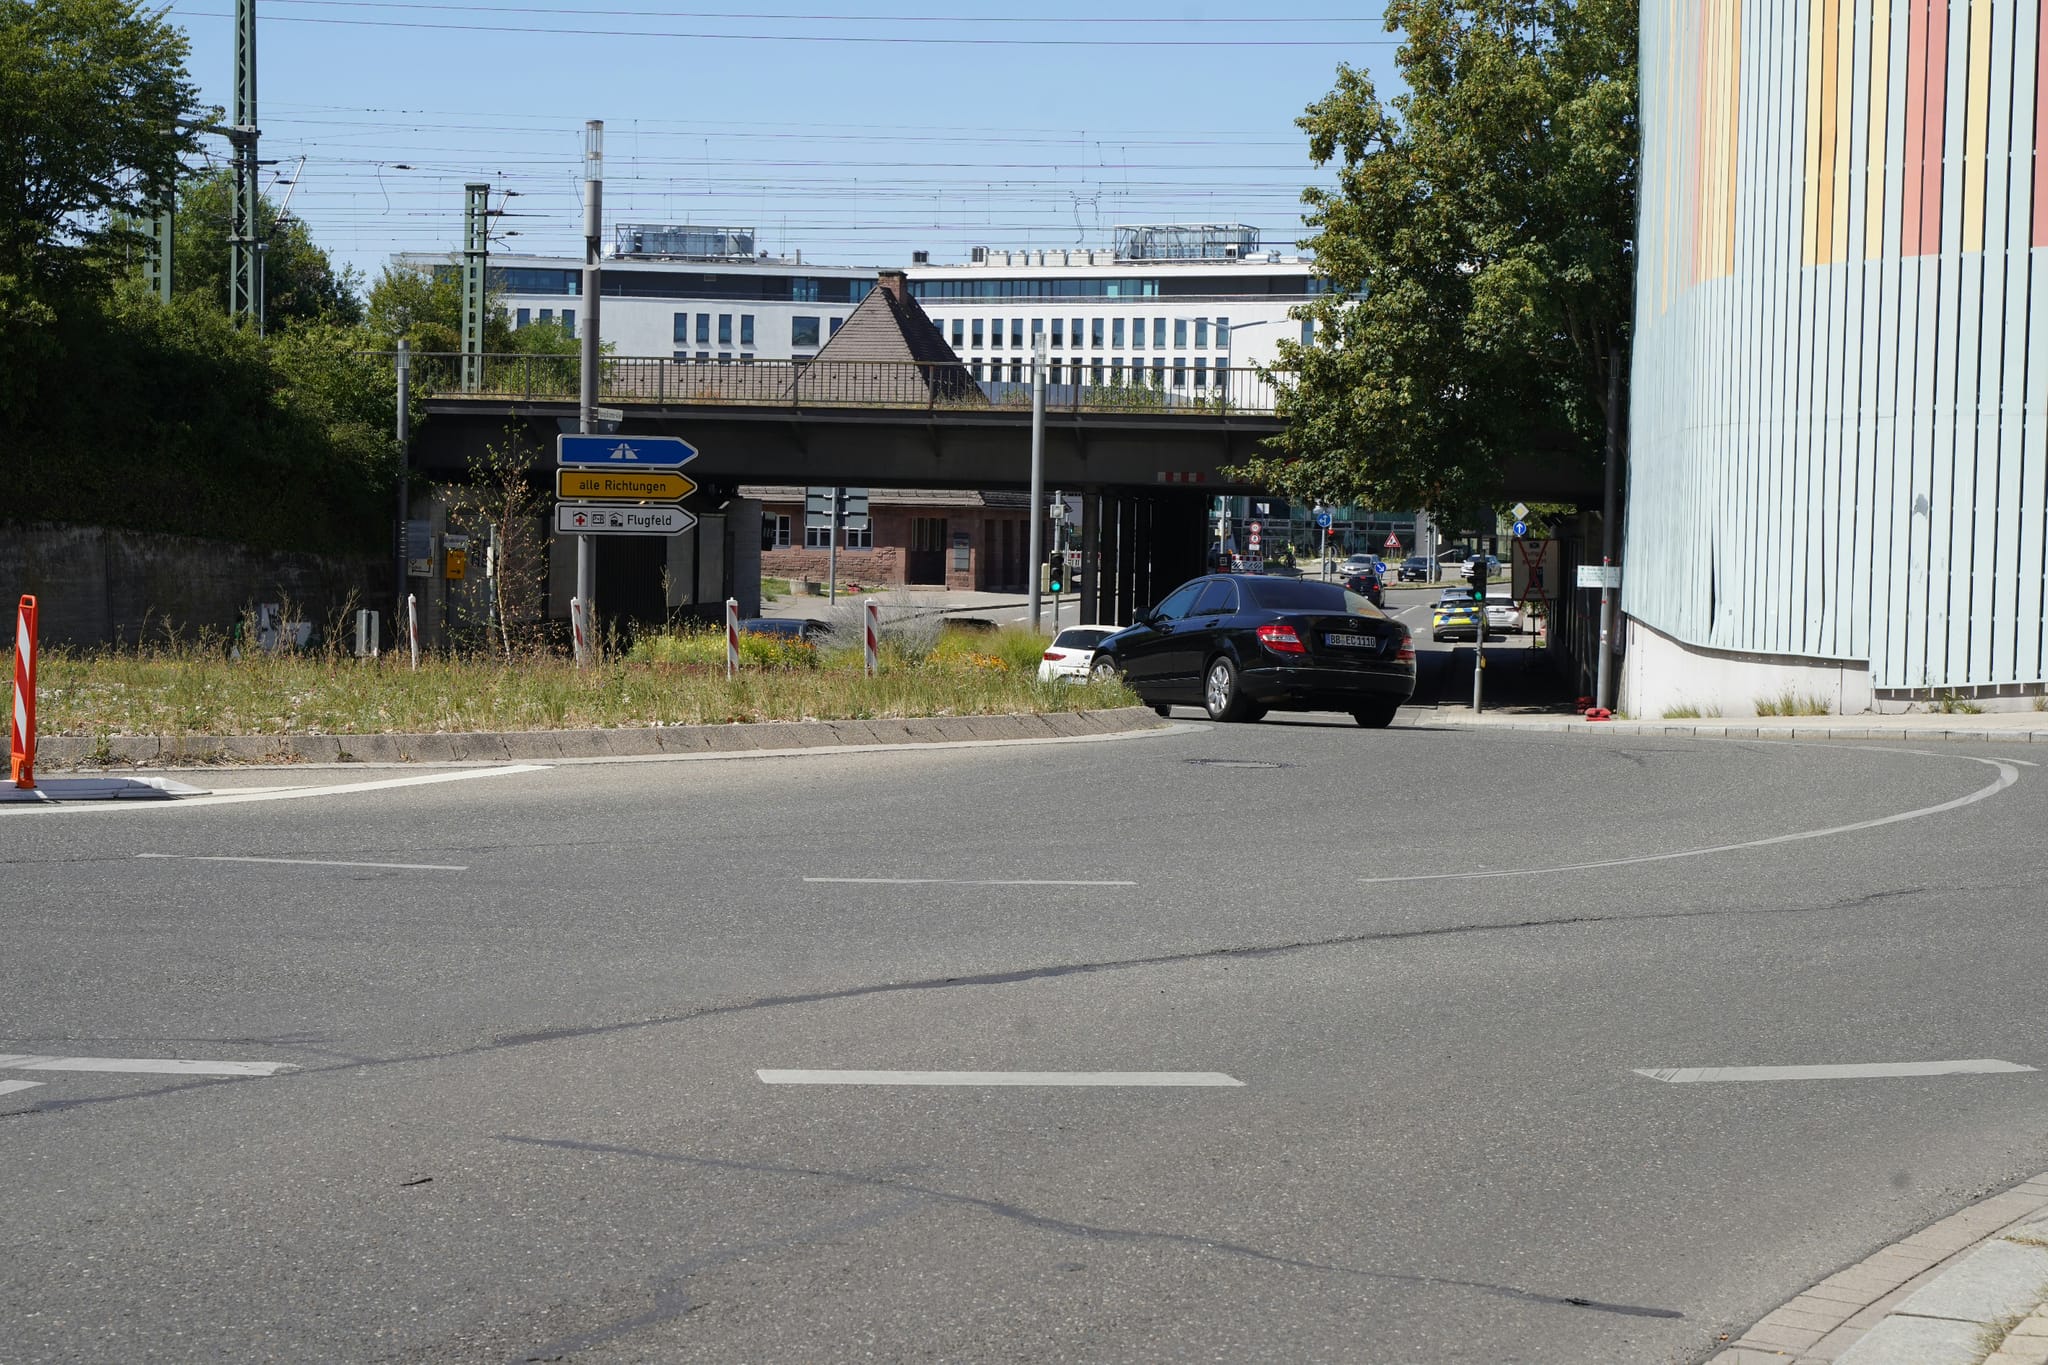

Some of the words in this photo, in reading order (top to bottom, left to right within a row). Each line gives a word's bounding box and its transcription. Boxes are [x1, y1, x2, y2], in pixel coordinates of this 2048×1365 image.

[579, 480, 600, 490] alle
[605, 480, 666, 493] Richtungen
[627, 514, 672, 527] Flugfeld
[1331, 635, 1341, 644] BB
